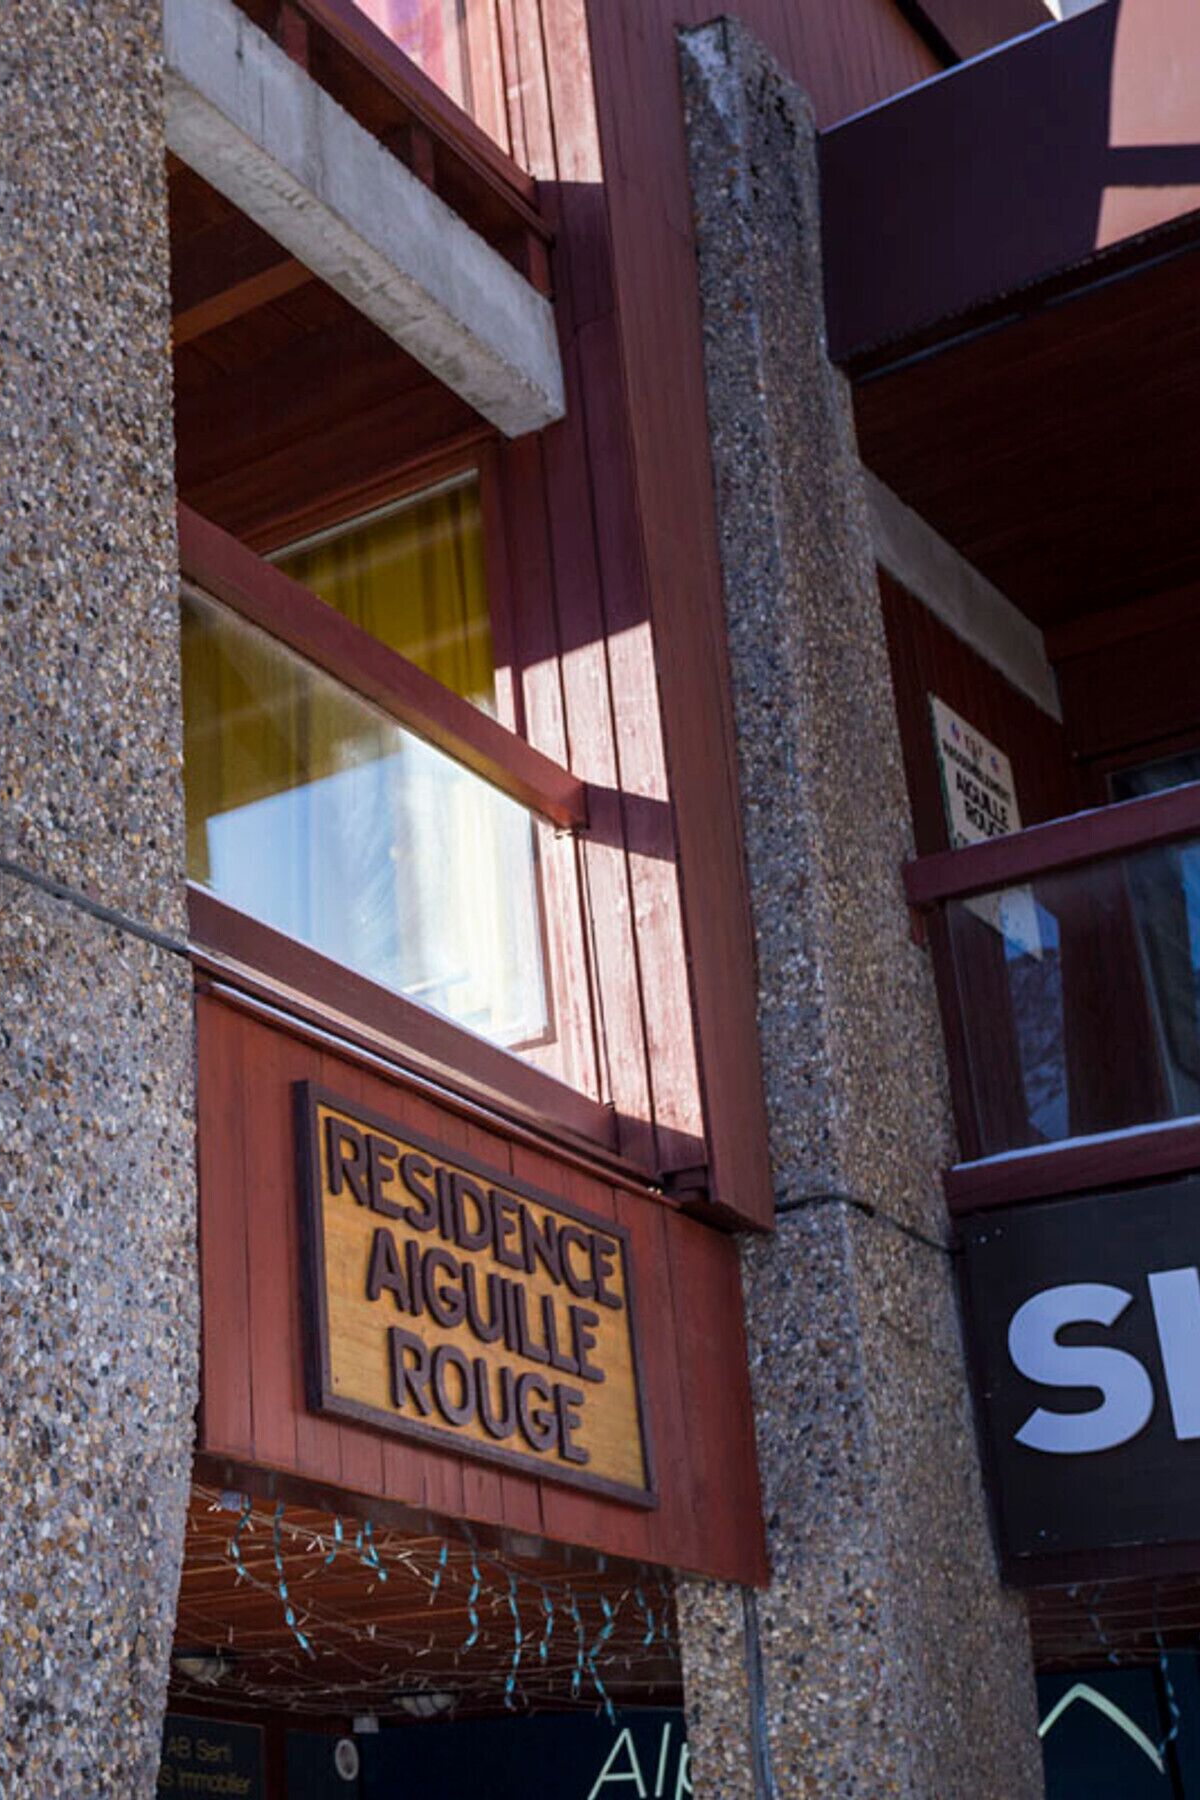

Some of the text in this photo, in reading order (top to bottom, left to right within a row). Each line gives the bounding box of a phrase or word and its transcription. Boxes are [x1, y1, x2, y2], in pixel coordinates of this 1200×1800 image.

[324, 1115, 623, 1310] RESIDENCE
[366, 1228, 605, 1383] AIGUILLE
[387, 1326, 590, 1465] ROUGE
